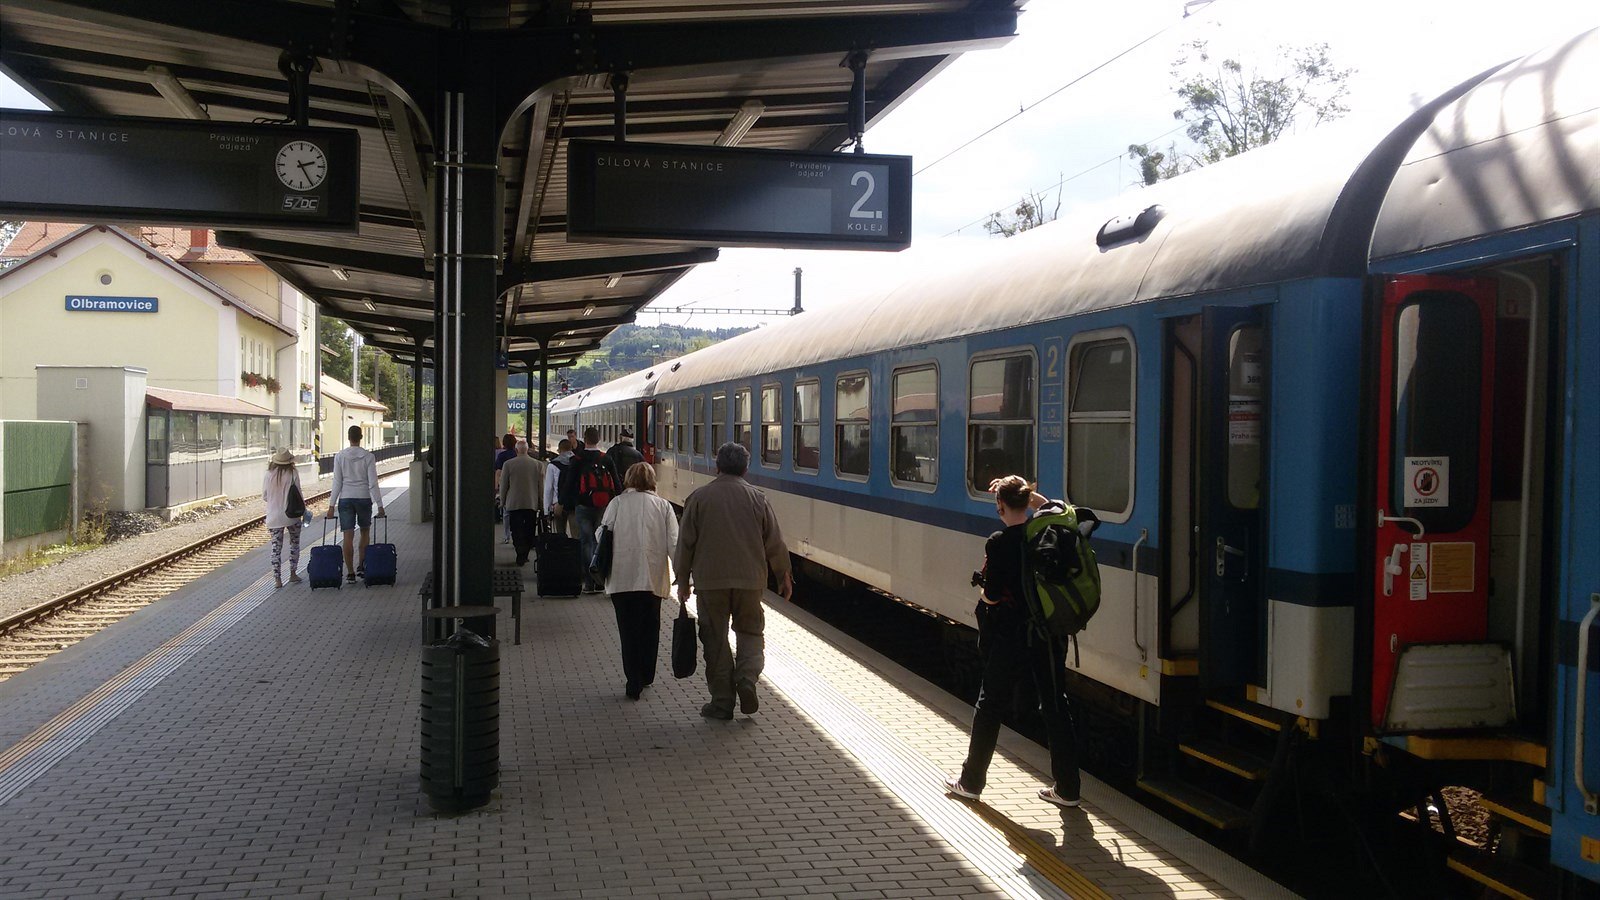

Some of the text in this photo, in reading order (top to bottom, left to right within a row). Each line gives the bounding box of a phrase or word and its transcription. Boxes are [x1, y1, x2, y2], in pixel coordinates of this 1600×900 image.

[0, 126, 129, 142] OVÁ STANICE
[219, 143, 251, 152] odjezd
[597, 156, 723, 171] CÍLOVÁ STANICE
[798, 170, 824, 178] odjezd
[849, 170, 883, 219] 2.
[847, 223, 883, 232] KOLEJ
[70, 298, 153, 310] Olbramovice
[1047, 344, 1059, 378] 2
[507, 400, 526, 410] vice
[1231, 432, 1250, 440] Praha
